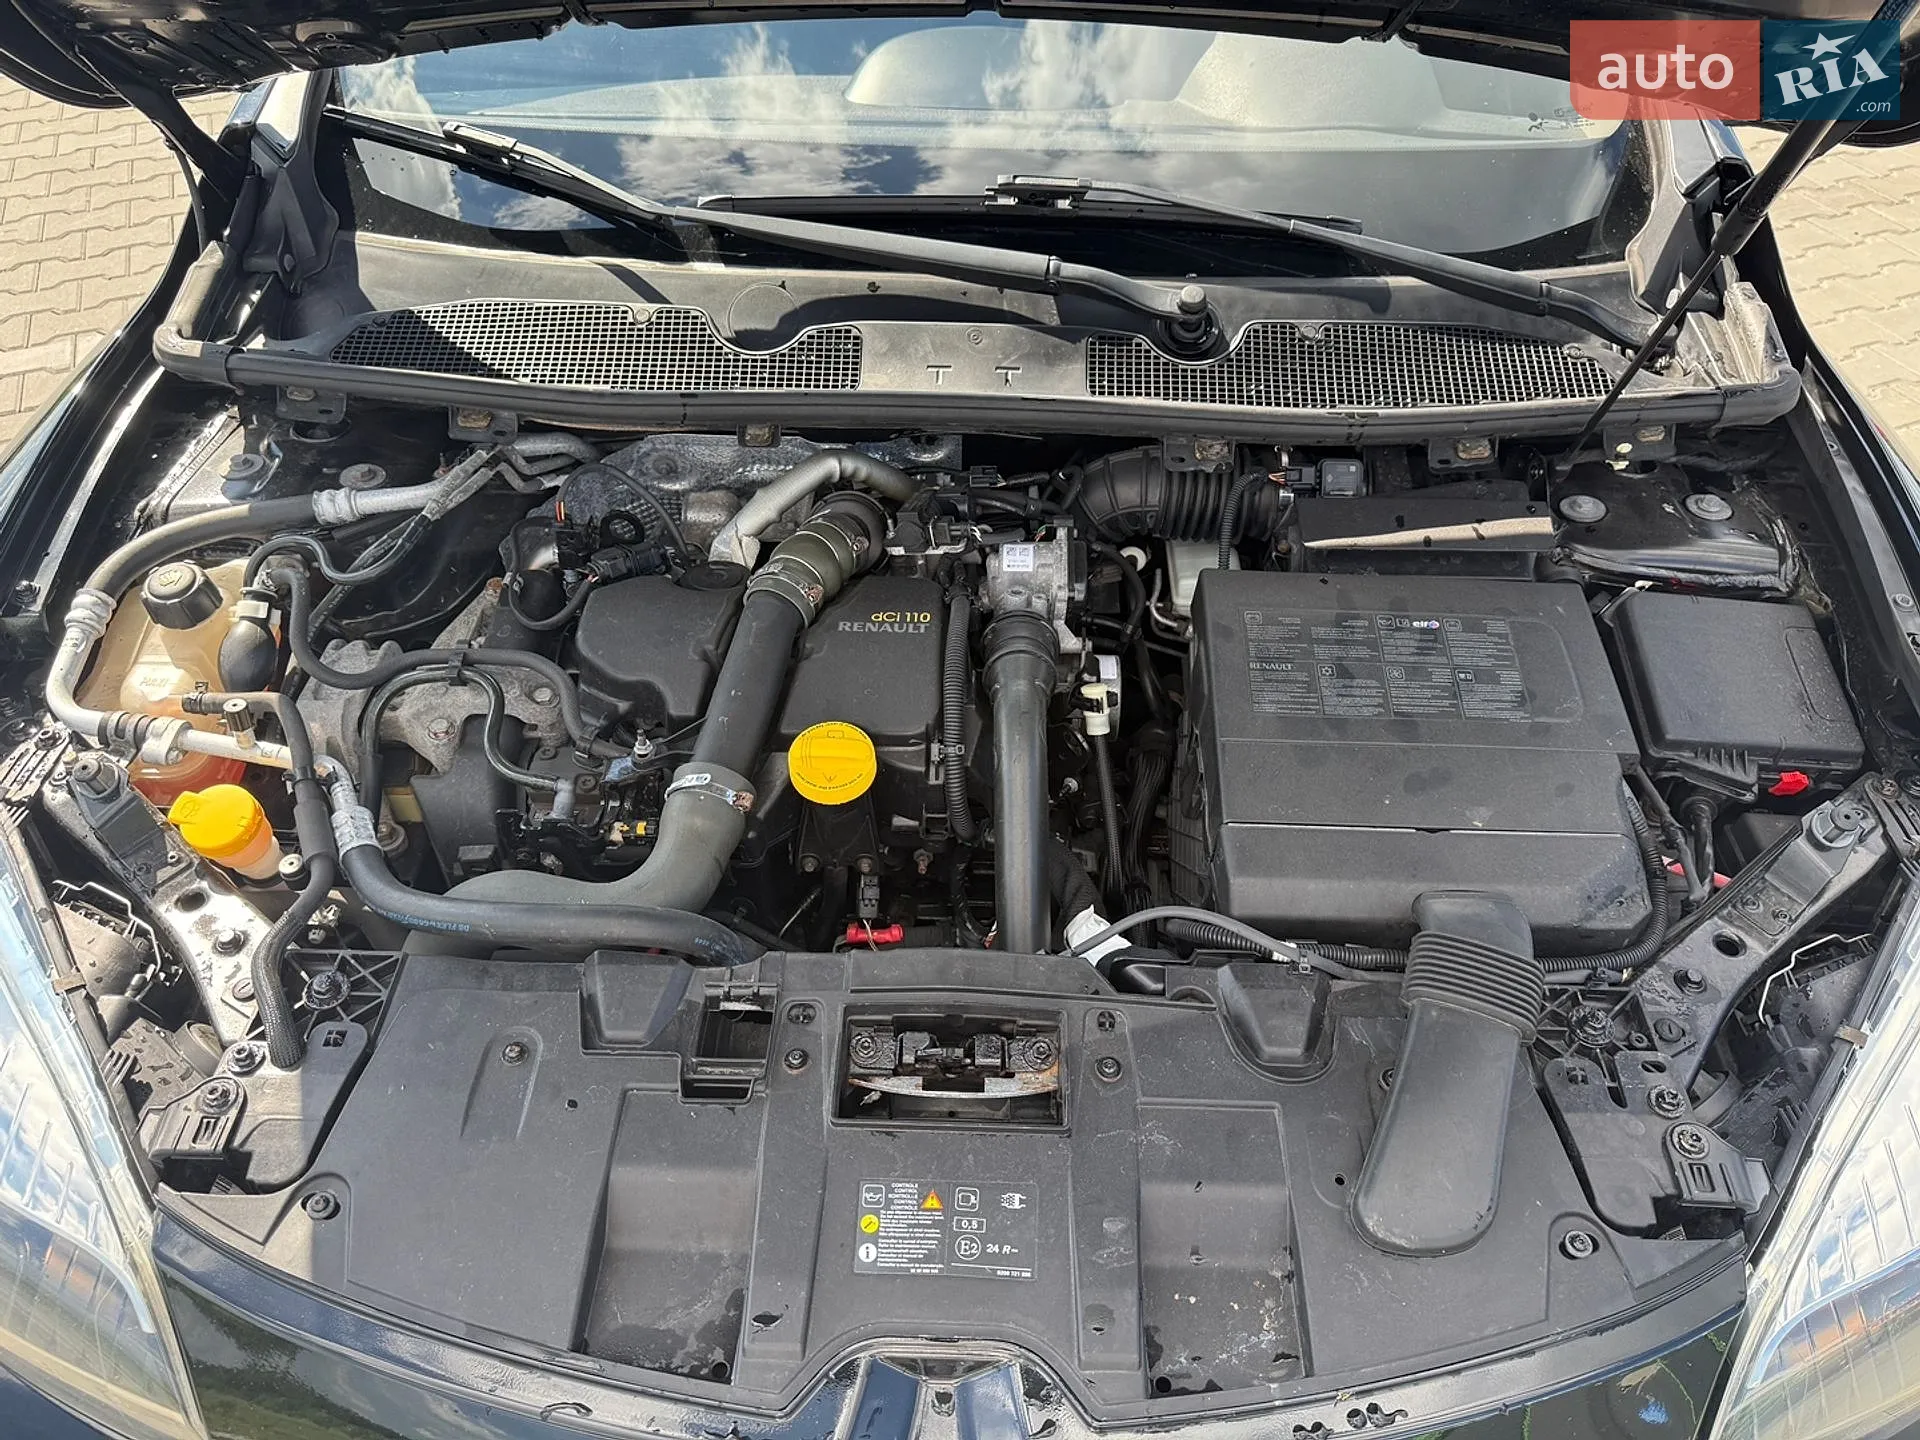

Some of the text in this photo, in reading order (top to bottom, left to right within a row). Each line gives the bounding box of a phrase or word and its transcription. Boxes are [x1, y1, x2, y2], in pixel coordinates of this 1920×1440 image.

[870, 611, 931, 623] dCi 110
[838, 621, 930, 633] RENAULT
[961, 1219, 978, 1230] 0,5
[960, 1239, 978, 1255] E2
[986, 1243, 999, 1253] 24
